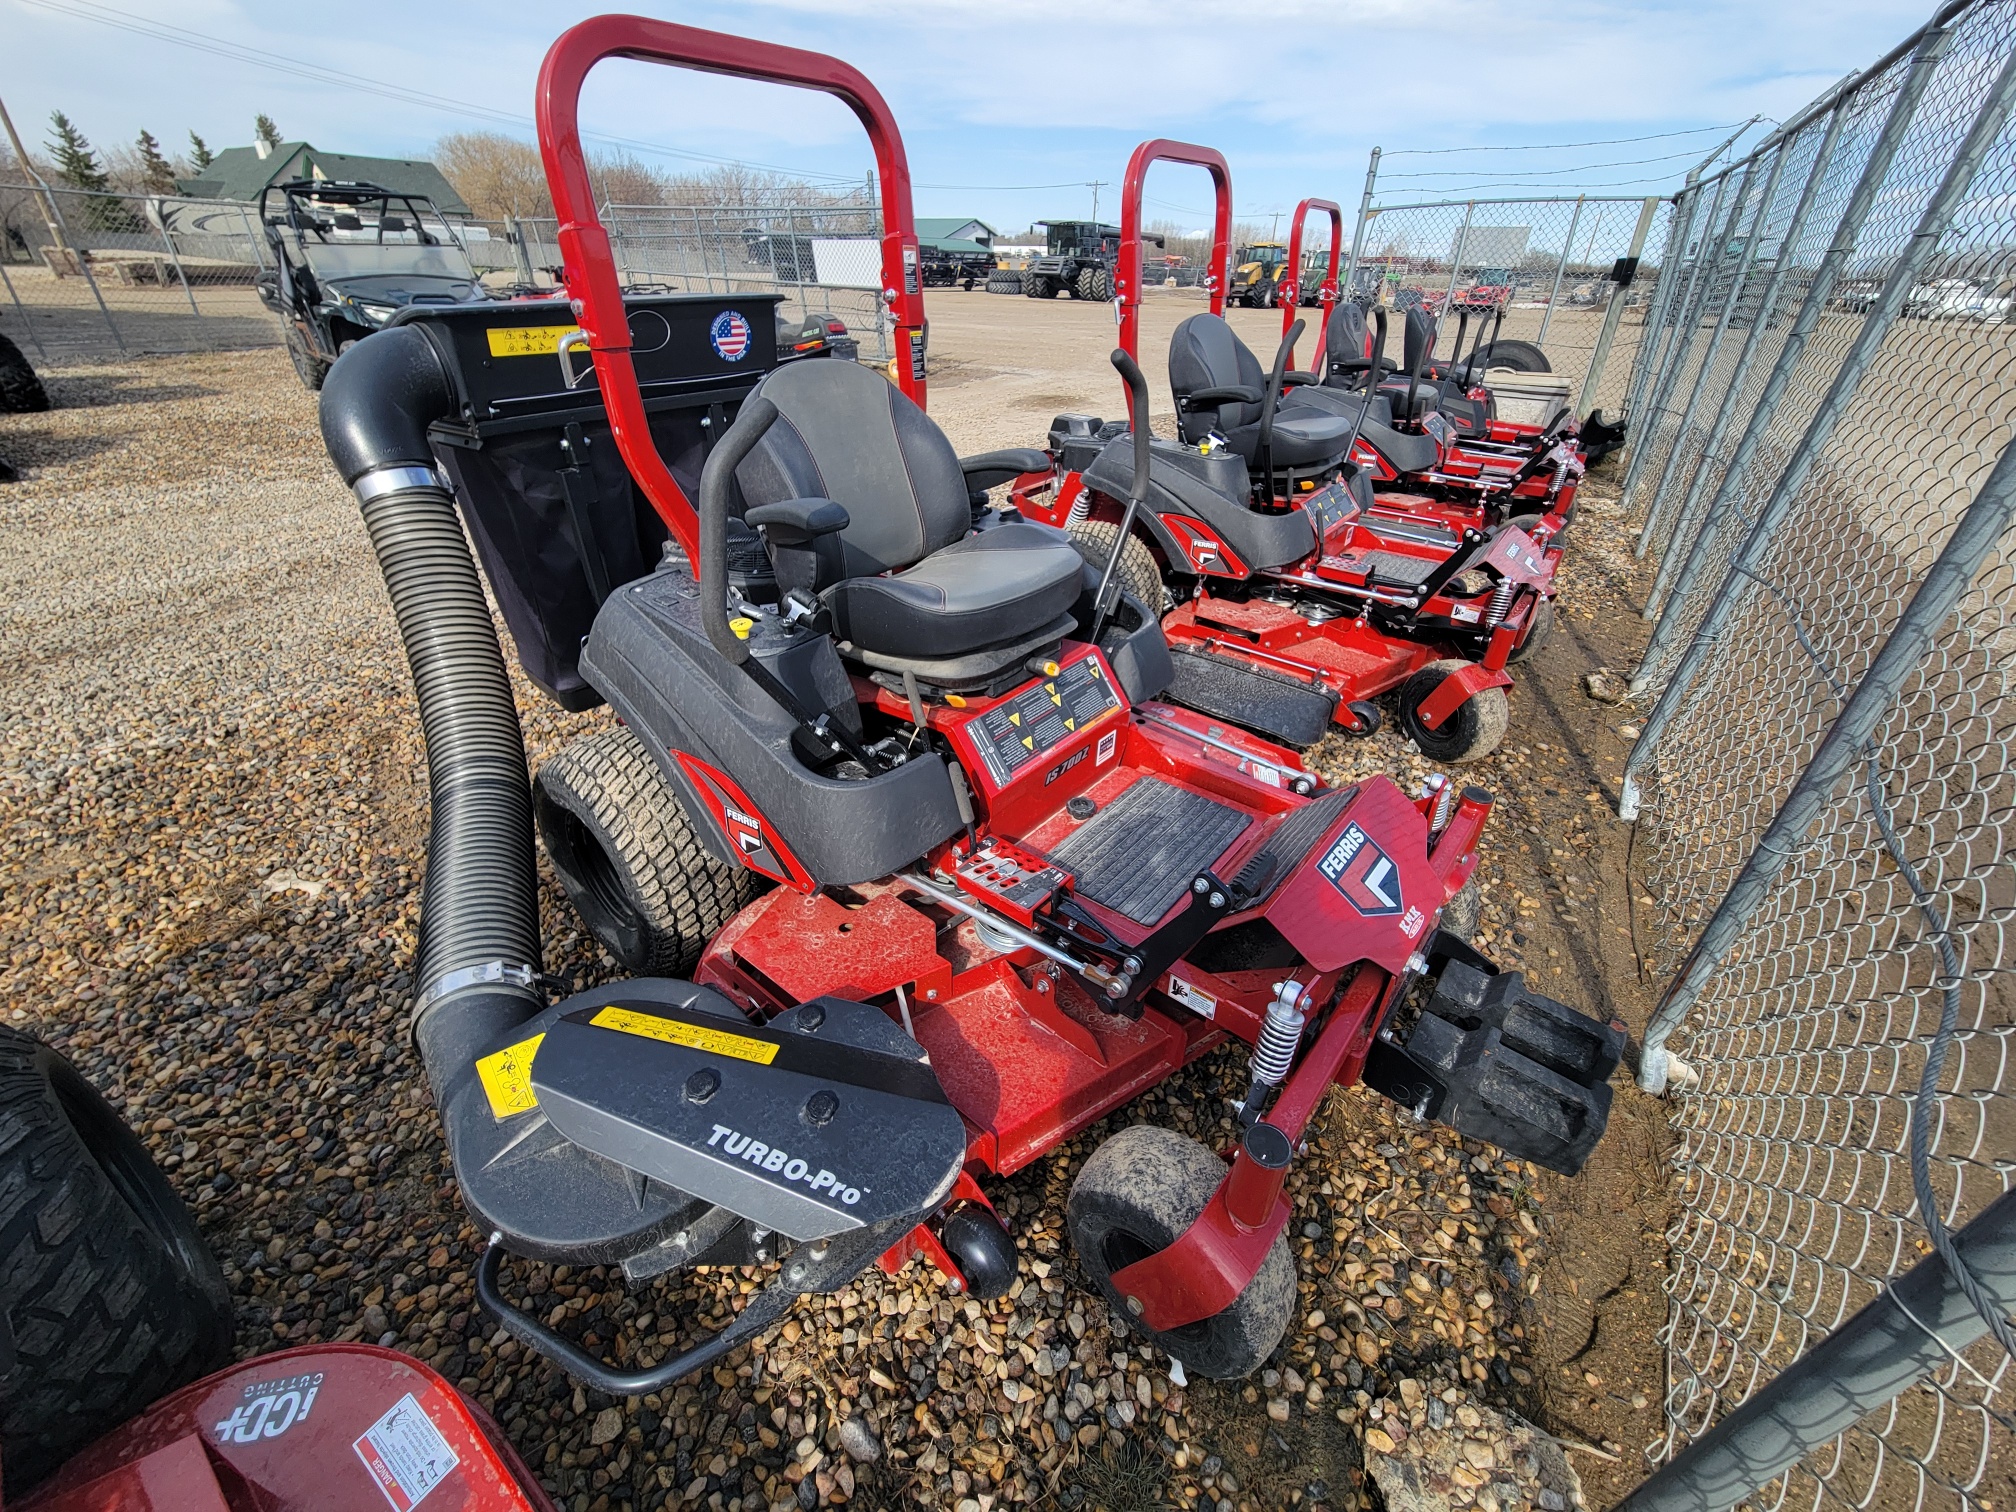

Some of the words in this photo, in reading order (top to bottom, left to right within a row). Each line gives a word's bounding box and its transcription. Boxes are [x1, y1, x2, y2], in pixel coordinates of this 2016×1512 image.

[711, 311, 729, 335] DESIGNED
[730, 310, 742, 319] AND
[740, 318, 751, 334] BUILT
[736, 350, 747, 360] USA
[1194, 540, 1217, 550] FERRIS
[1045, 770, 1058, 786] IS
[1059, 746, 1090, 776] 700Z
[727, 809, 759, 830] FERRIS
[1321, 827, 1366, 880] FERRIS
[1398, 905, 1422, 935] KMK
[245, 1372, 324, 1398] CUTTING
[372, 1457, 393, 1485] DANGER
[398, 1476, 414, 1496] Amputation
